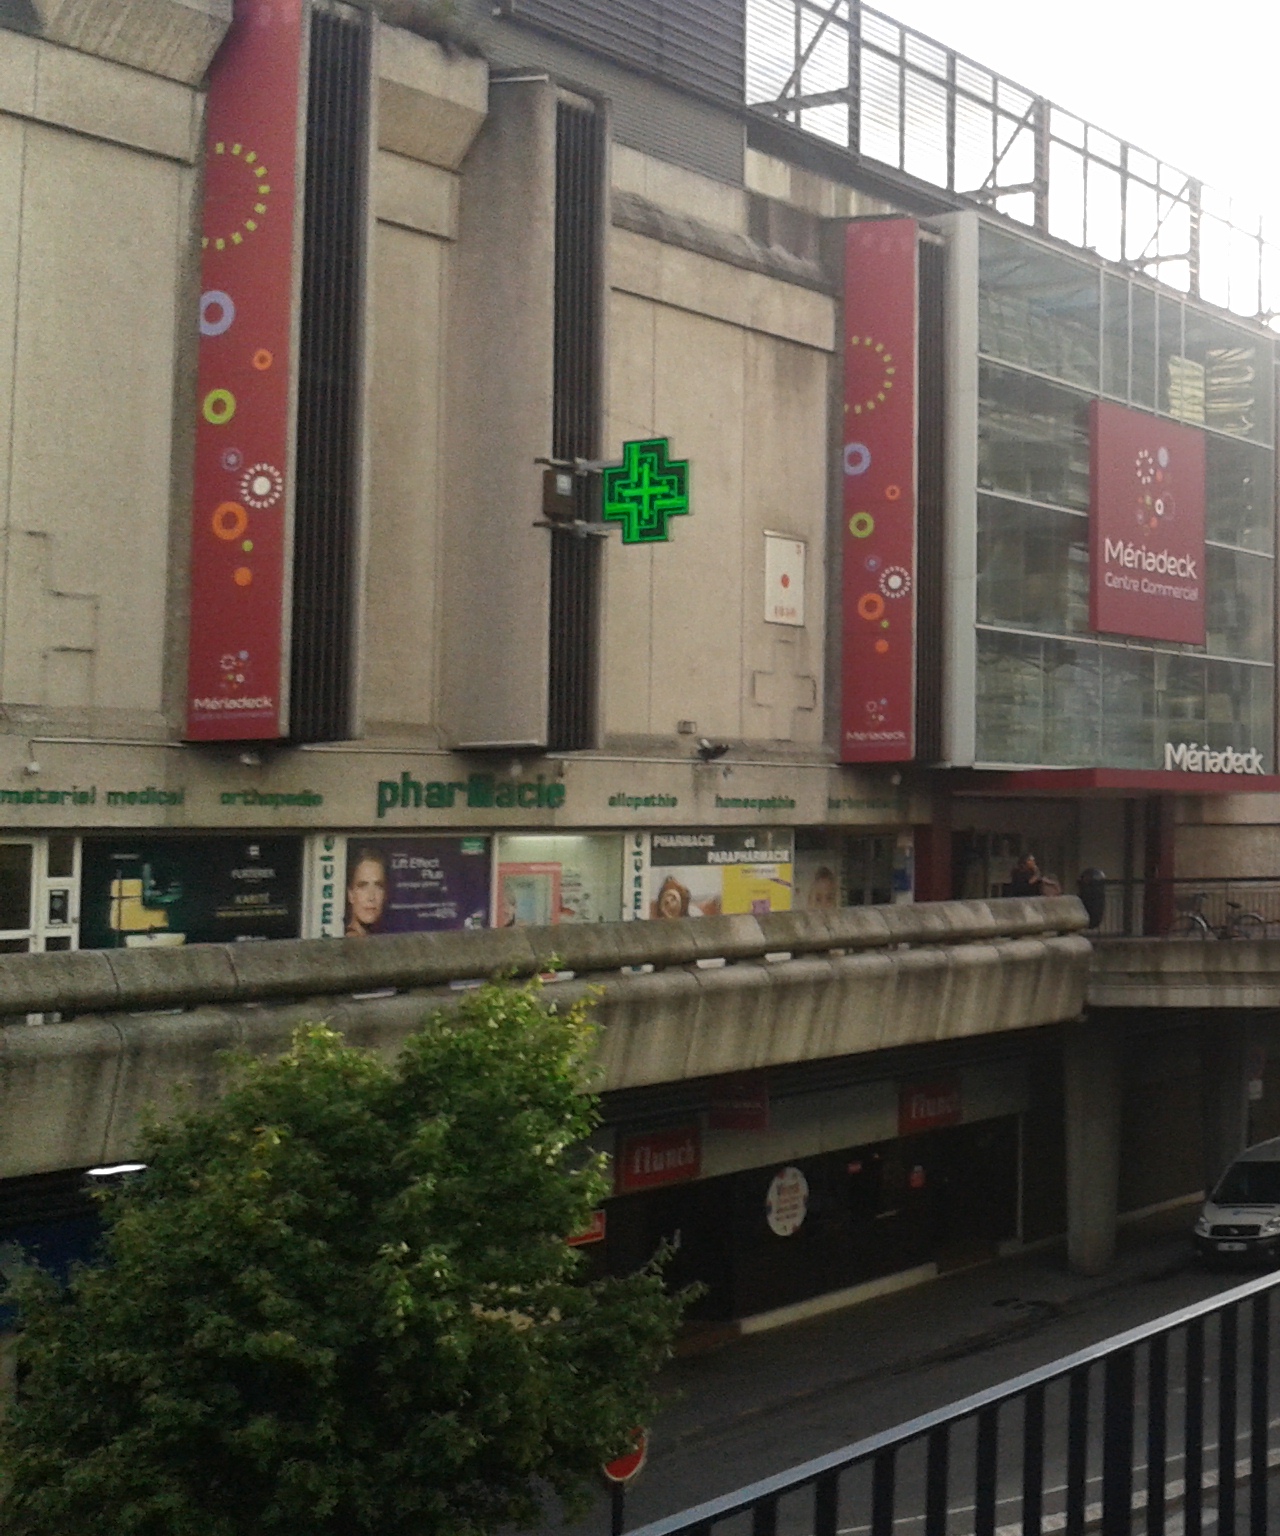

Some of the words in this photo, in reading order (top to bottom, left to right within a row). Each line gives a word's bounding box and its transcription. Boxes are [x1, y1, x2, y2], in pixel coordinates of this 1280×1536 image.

[1104, 537, 1198, 579] Mériadeck
[1104, 571, 1139, 592] Centre
[1140, 578, 1199, 601] Commercial
[1164, 742, 1265, 775] Mériadeck
[376, 771, 567, 818] pharmacie
[653, 834, 715, 848] PHARMACIE
